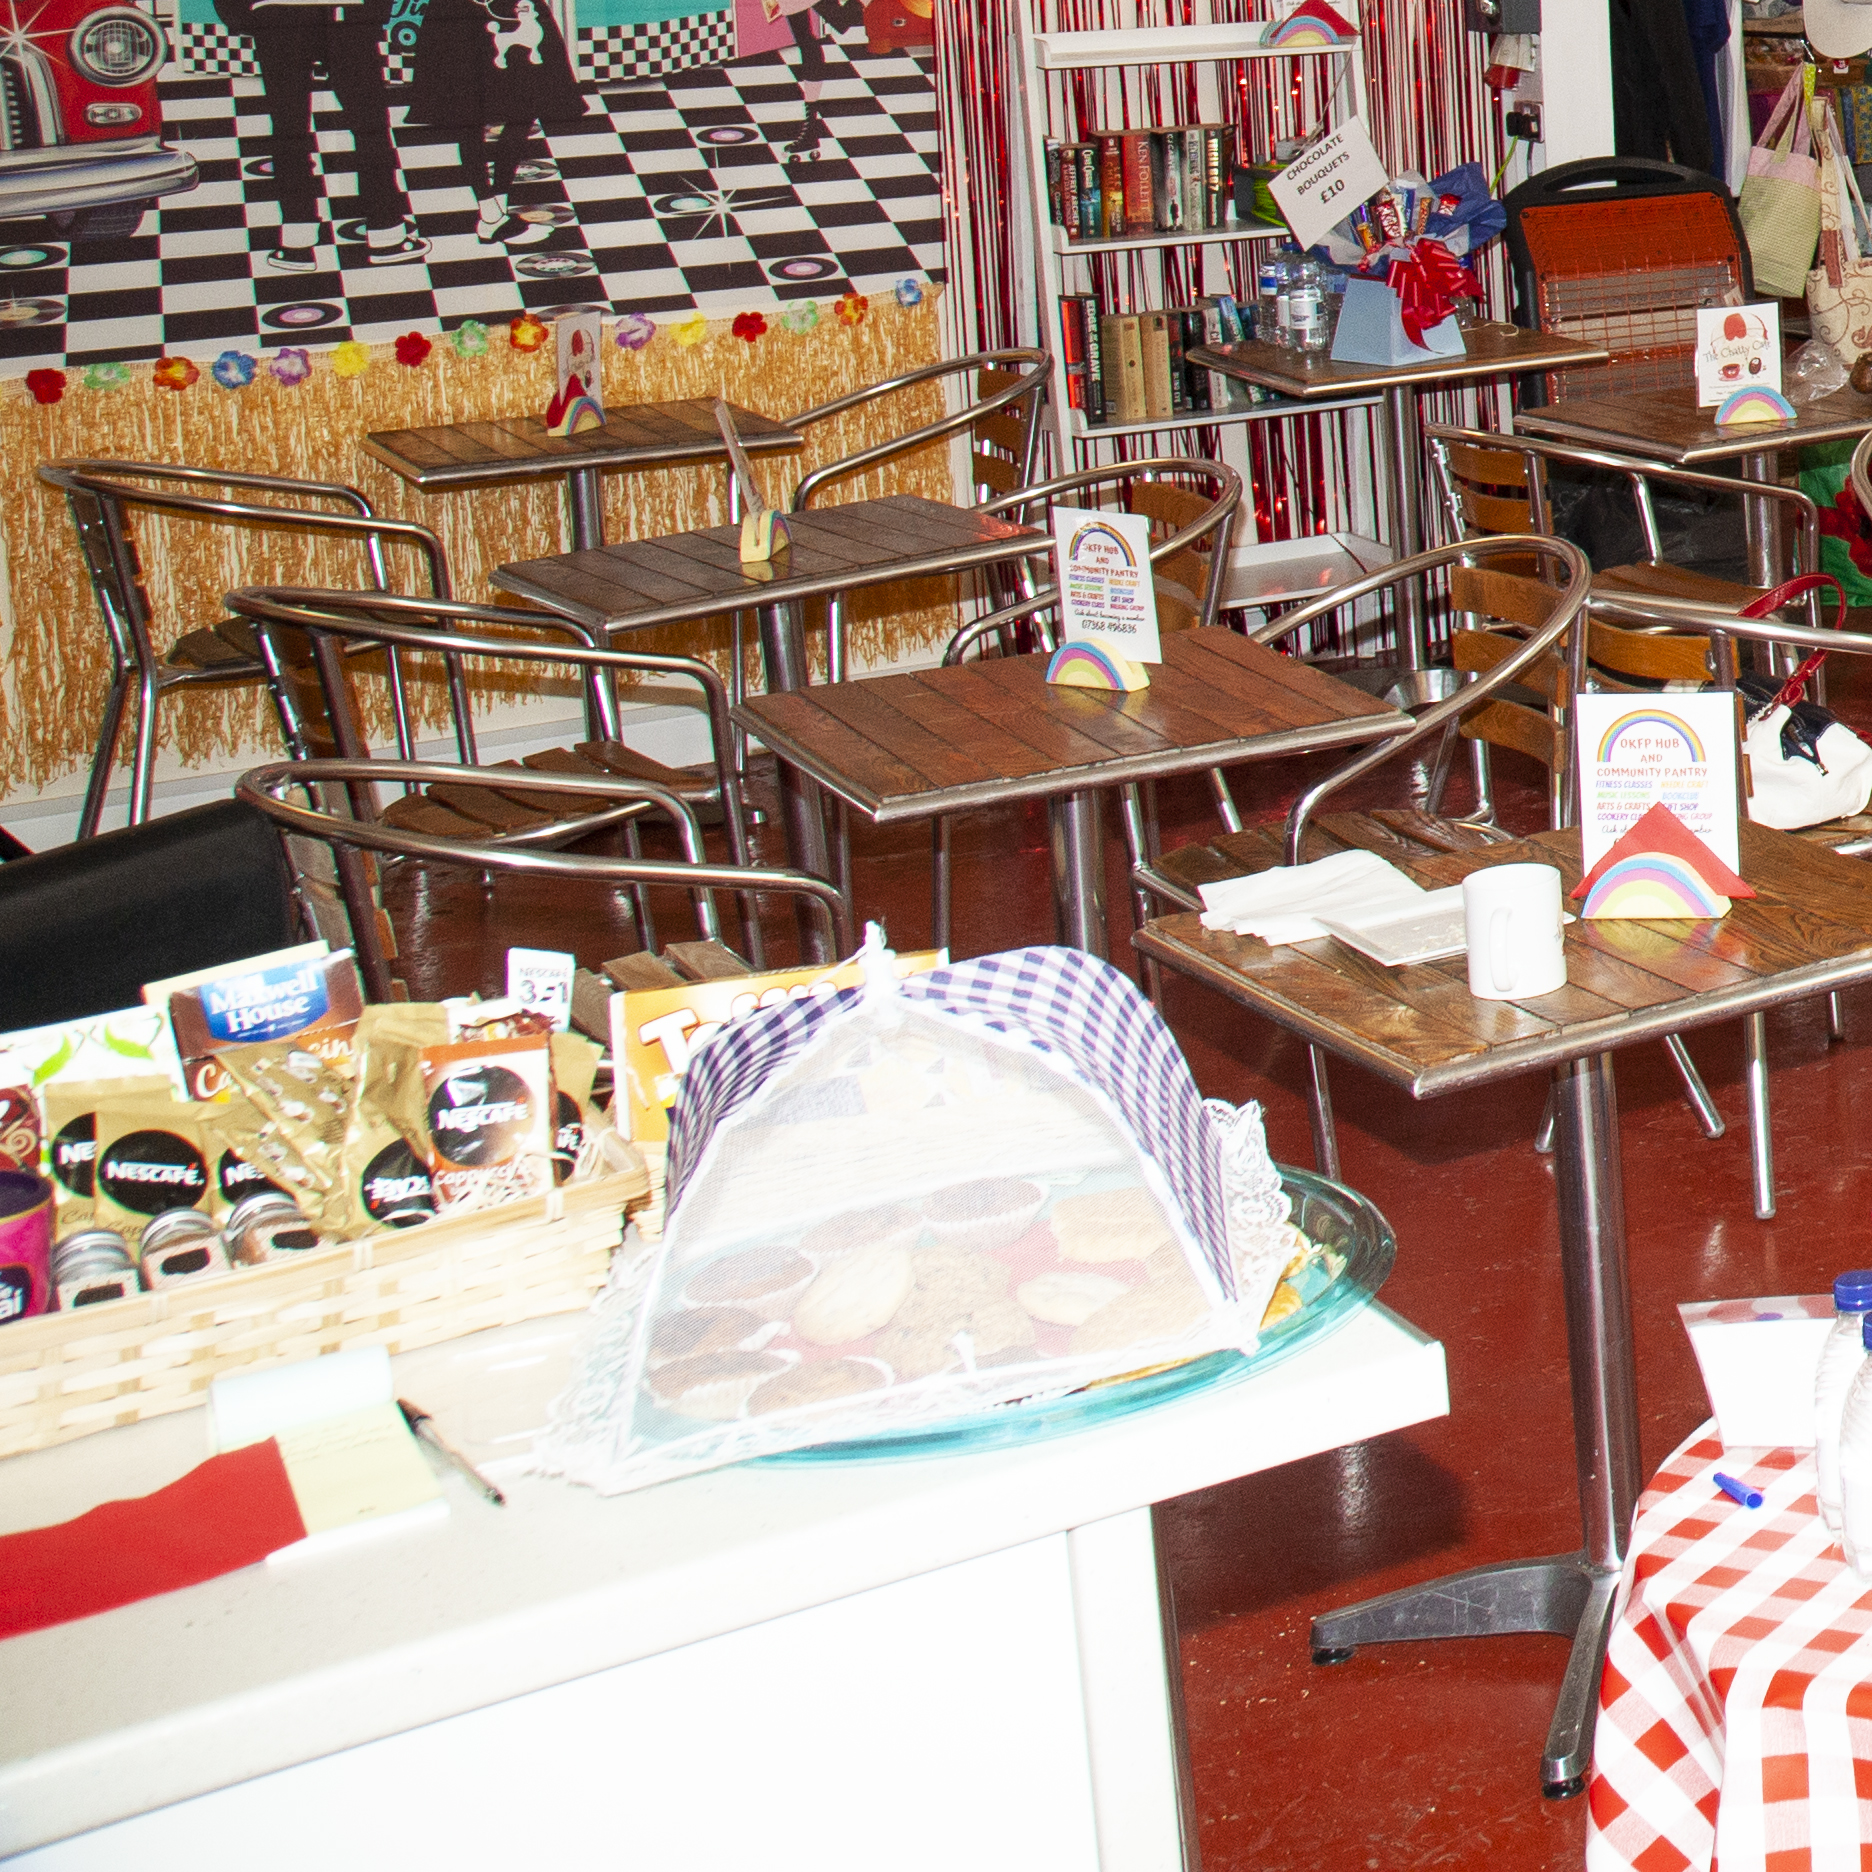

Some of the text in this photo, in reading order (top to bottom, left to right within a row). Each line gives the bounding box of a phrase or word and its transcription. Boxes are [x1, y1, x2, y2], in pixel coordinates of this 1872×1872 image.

[1286, 132, 1345, 181] CHOCOLATE
[1136, 140, 1150, 212] KEN FOLLETT
[1296, 151, 1350, 195] BOUQUETS
[1319, 179, 1346, 205] £10
[1619, 738, 1680, 750] OKFP HUB
[1640, 754, 1663, 764] AND
[1595, 780, 1654, 789] FITNESS CLASSES
[1596, 767, 1708, 778] COMMUNITY PANTRY
[1596, 802, 1615, 811] ARTS
[1624, 802, 1651, 811] CRAFTS
[209, 966, 320, 1015] Maxwell
[224, 995, 312, 1034] House
